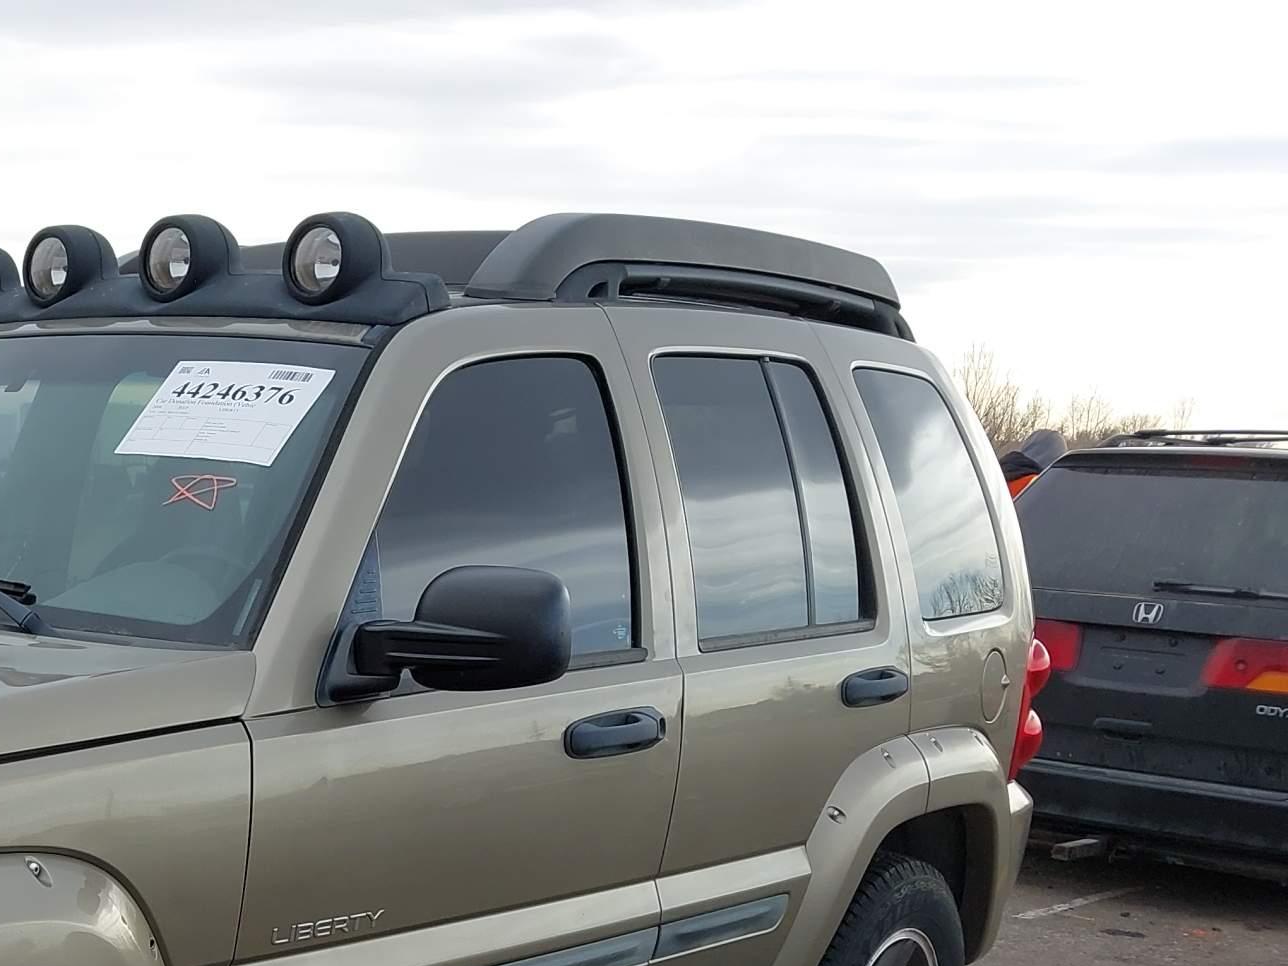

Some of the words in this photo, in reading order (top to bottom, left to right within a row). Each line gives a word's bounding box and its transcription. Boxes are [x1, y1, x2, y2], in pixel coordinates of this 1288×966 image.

[171, 381, 301, 406] 44246376
[1255, 704, 1288, 718] ODY
[271, 909, 385, 945] LIBERTY
